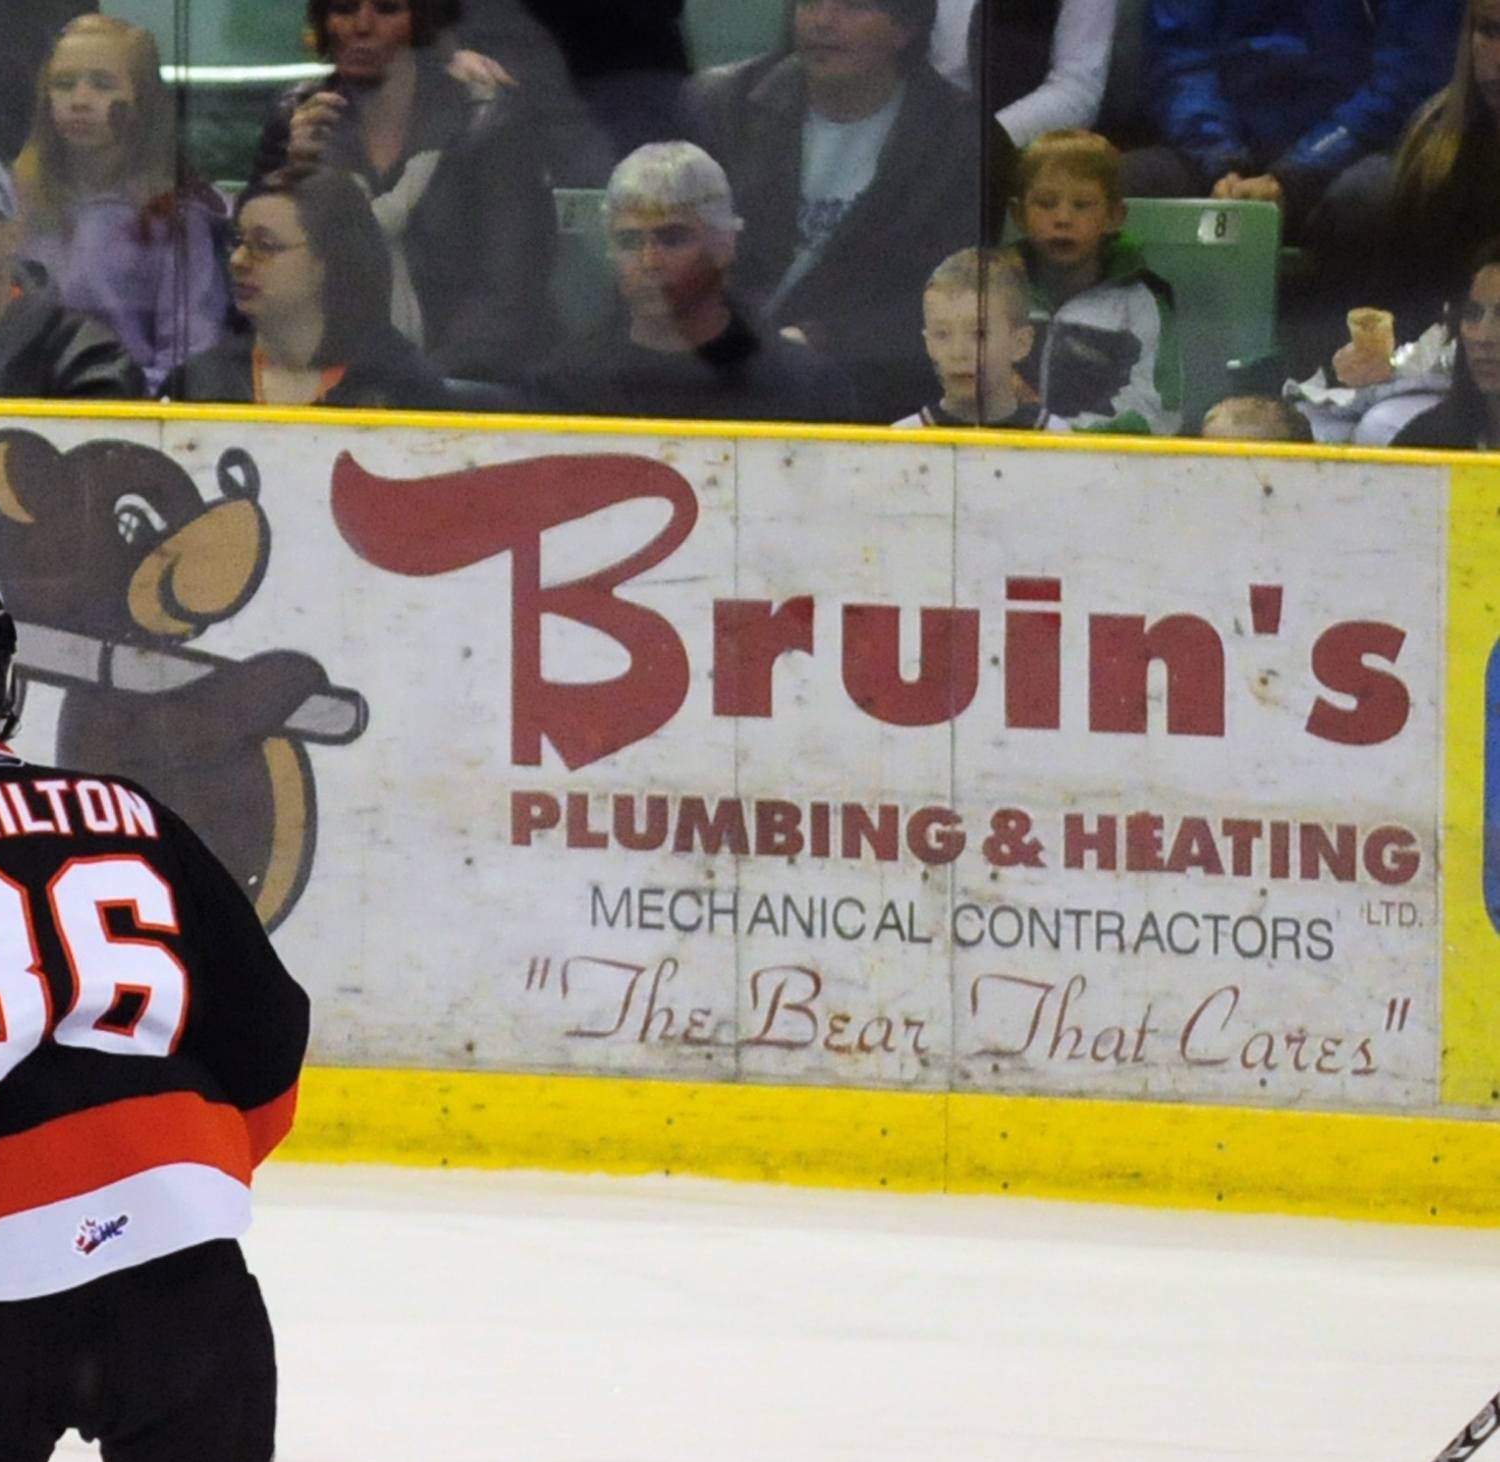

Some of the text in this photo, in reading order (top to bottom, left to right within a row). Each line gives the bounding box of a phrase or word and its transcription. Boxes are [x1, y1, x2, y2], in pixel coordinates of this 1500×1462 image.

[1213, 211, 1228, 239] 8
[331, 449, 1412, 771] Bruin's
[510, 790, 1422, 886] PLUMBING & HEATING
[589, 886, 1335, 960] MECHANICAL CONTRACTORS
[1366, 901, 1424, 929] LTD.
[740, 964, 930, 1055] Bear
[970, 971, 1156, 1061] That
